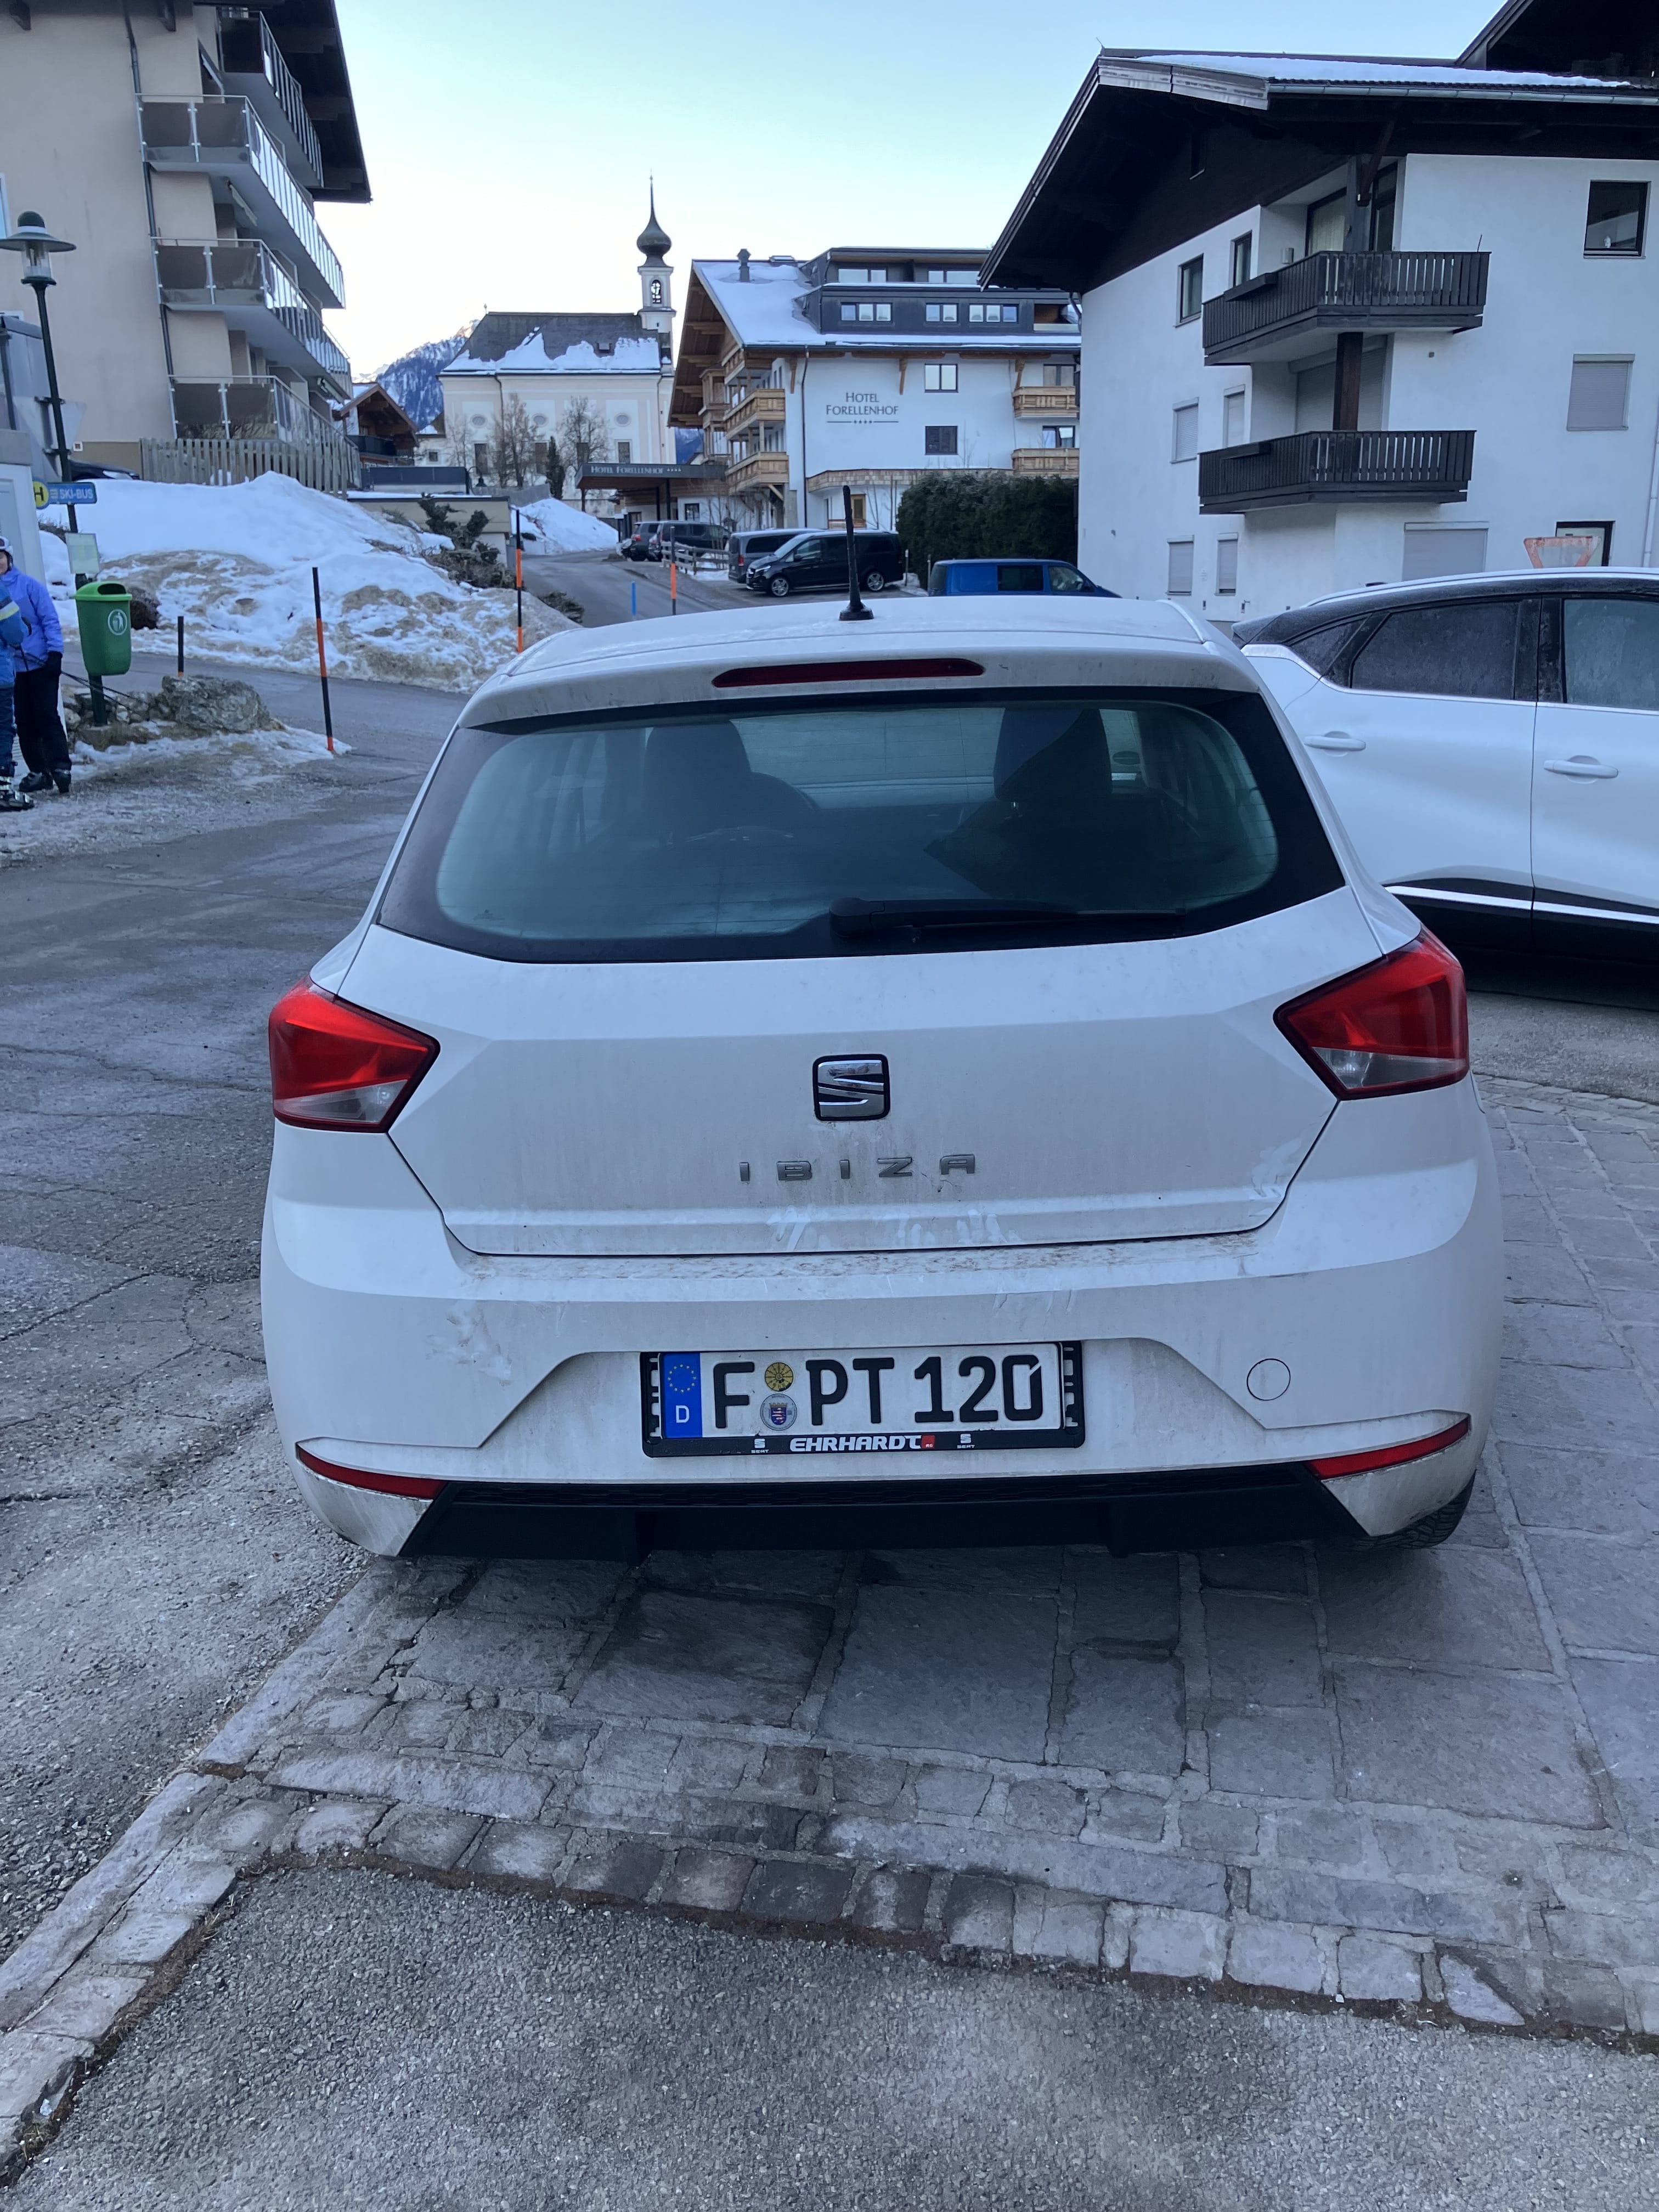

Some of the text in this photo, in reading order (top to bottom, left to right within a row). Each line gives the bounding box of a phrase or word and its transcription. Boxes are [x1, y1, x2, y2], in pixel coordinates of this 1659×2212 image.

[845, 392, 880, 403] HOTEL
[826, 405, 899, 415] FORELLENHOF
[60, 488, 93, 499] SKI-BUS
[739, 1154, 975, 1182] IBIZA
[675, 1405, 690, 1423] D
[789, 1435, 922, 1452] EHRHARDT
